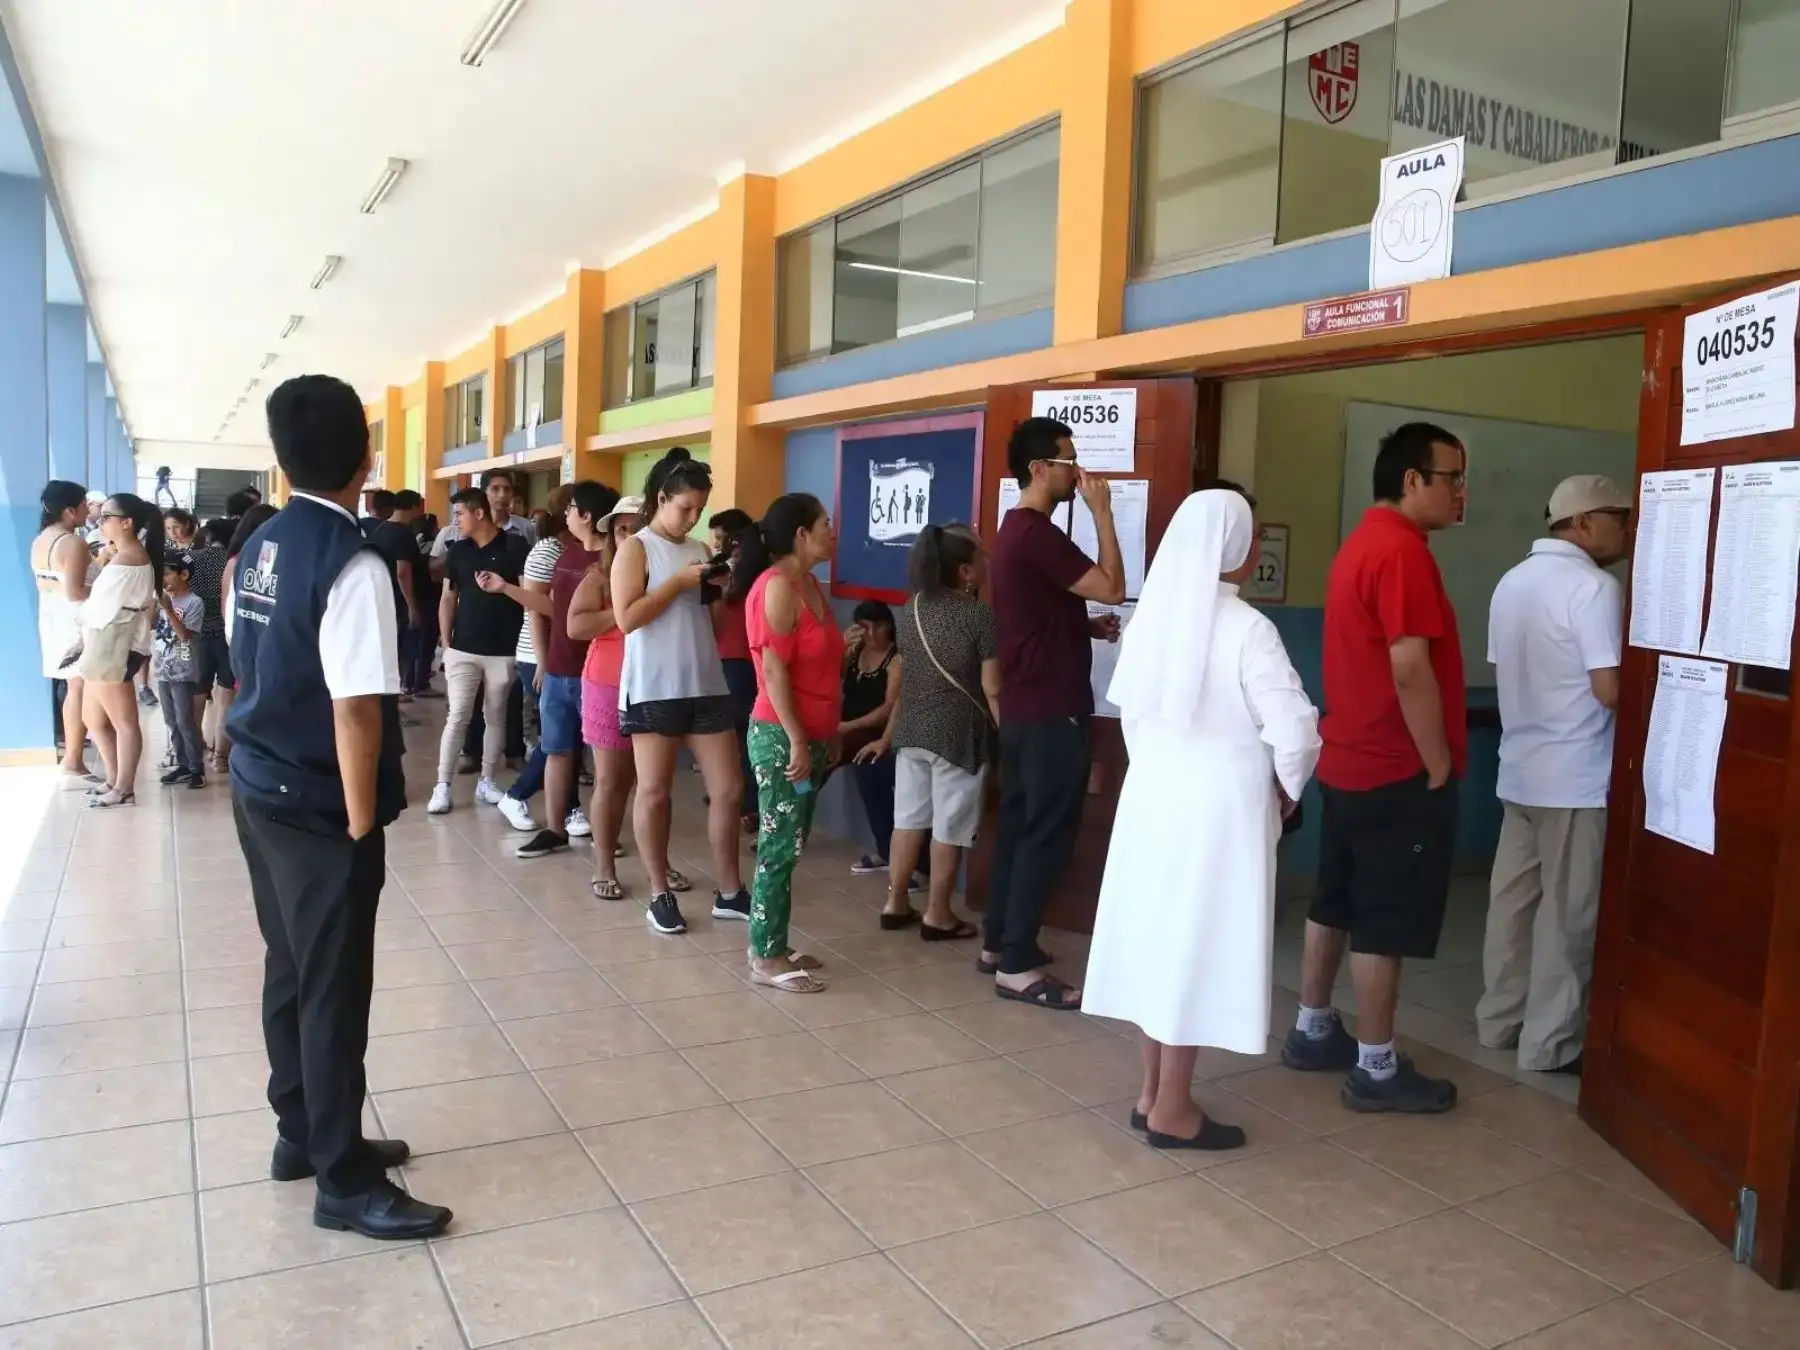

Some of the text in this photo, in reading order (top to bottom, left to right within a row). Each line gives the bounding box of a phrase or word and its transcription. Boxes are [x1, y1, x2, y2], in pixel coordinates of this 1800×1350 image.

[1394, 69, 1426, 130] LAS
[1427, 80, 1487, 147] DAMAS
[1489, 99, 1502, 151] Y
[1396, 153, 1446, 179] AULA
[1386, 200, 1431, 248] 501
[1324, 295, 1403, 319] AULA FUNCIONAL 1
[1724, 310, 1734, 322] DE
[1734, 304, 1756, 318] MESA
[1697, 315, 1776, 366] 040535
[1047, 404, 1119, 424] 040536
[244, 568, 278, 596] ONPE
[1257, 564, 1276, 582] 12
